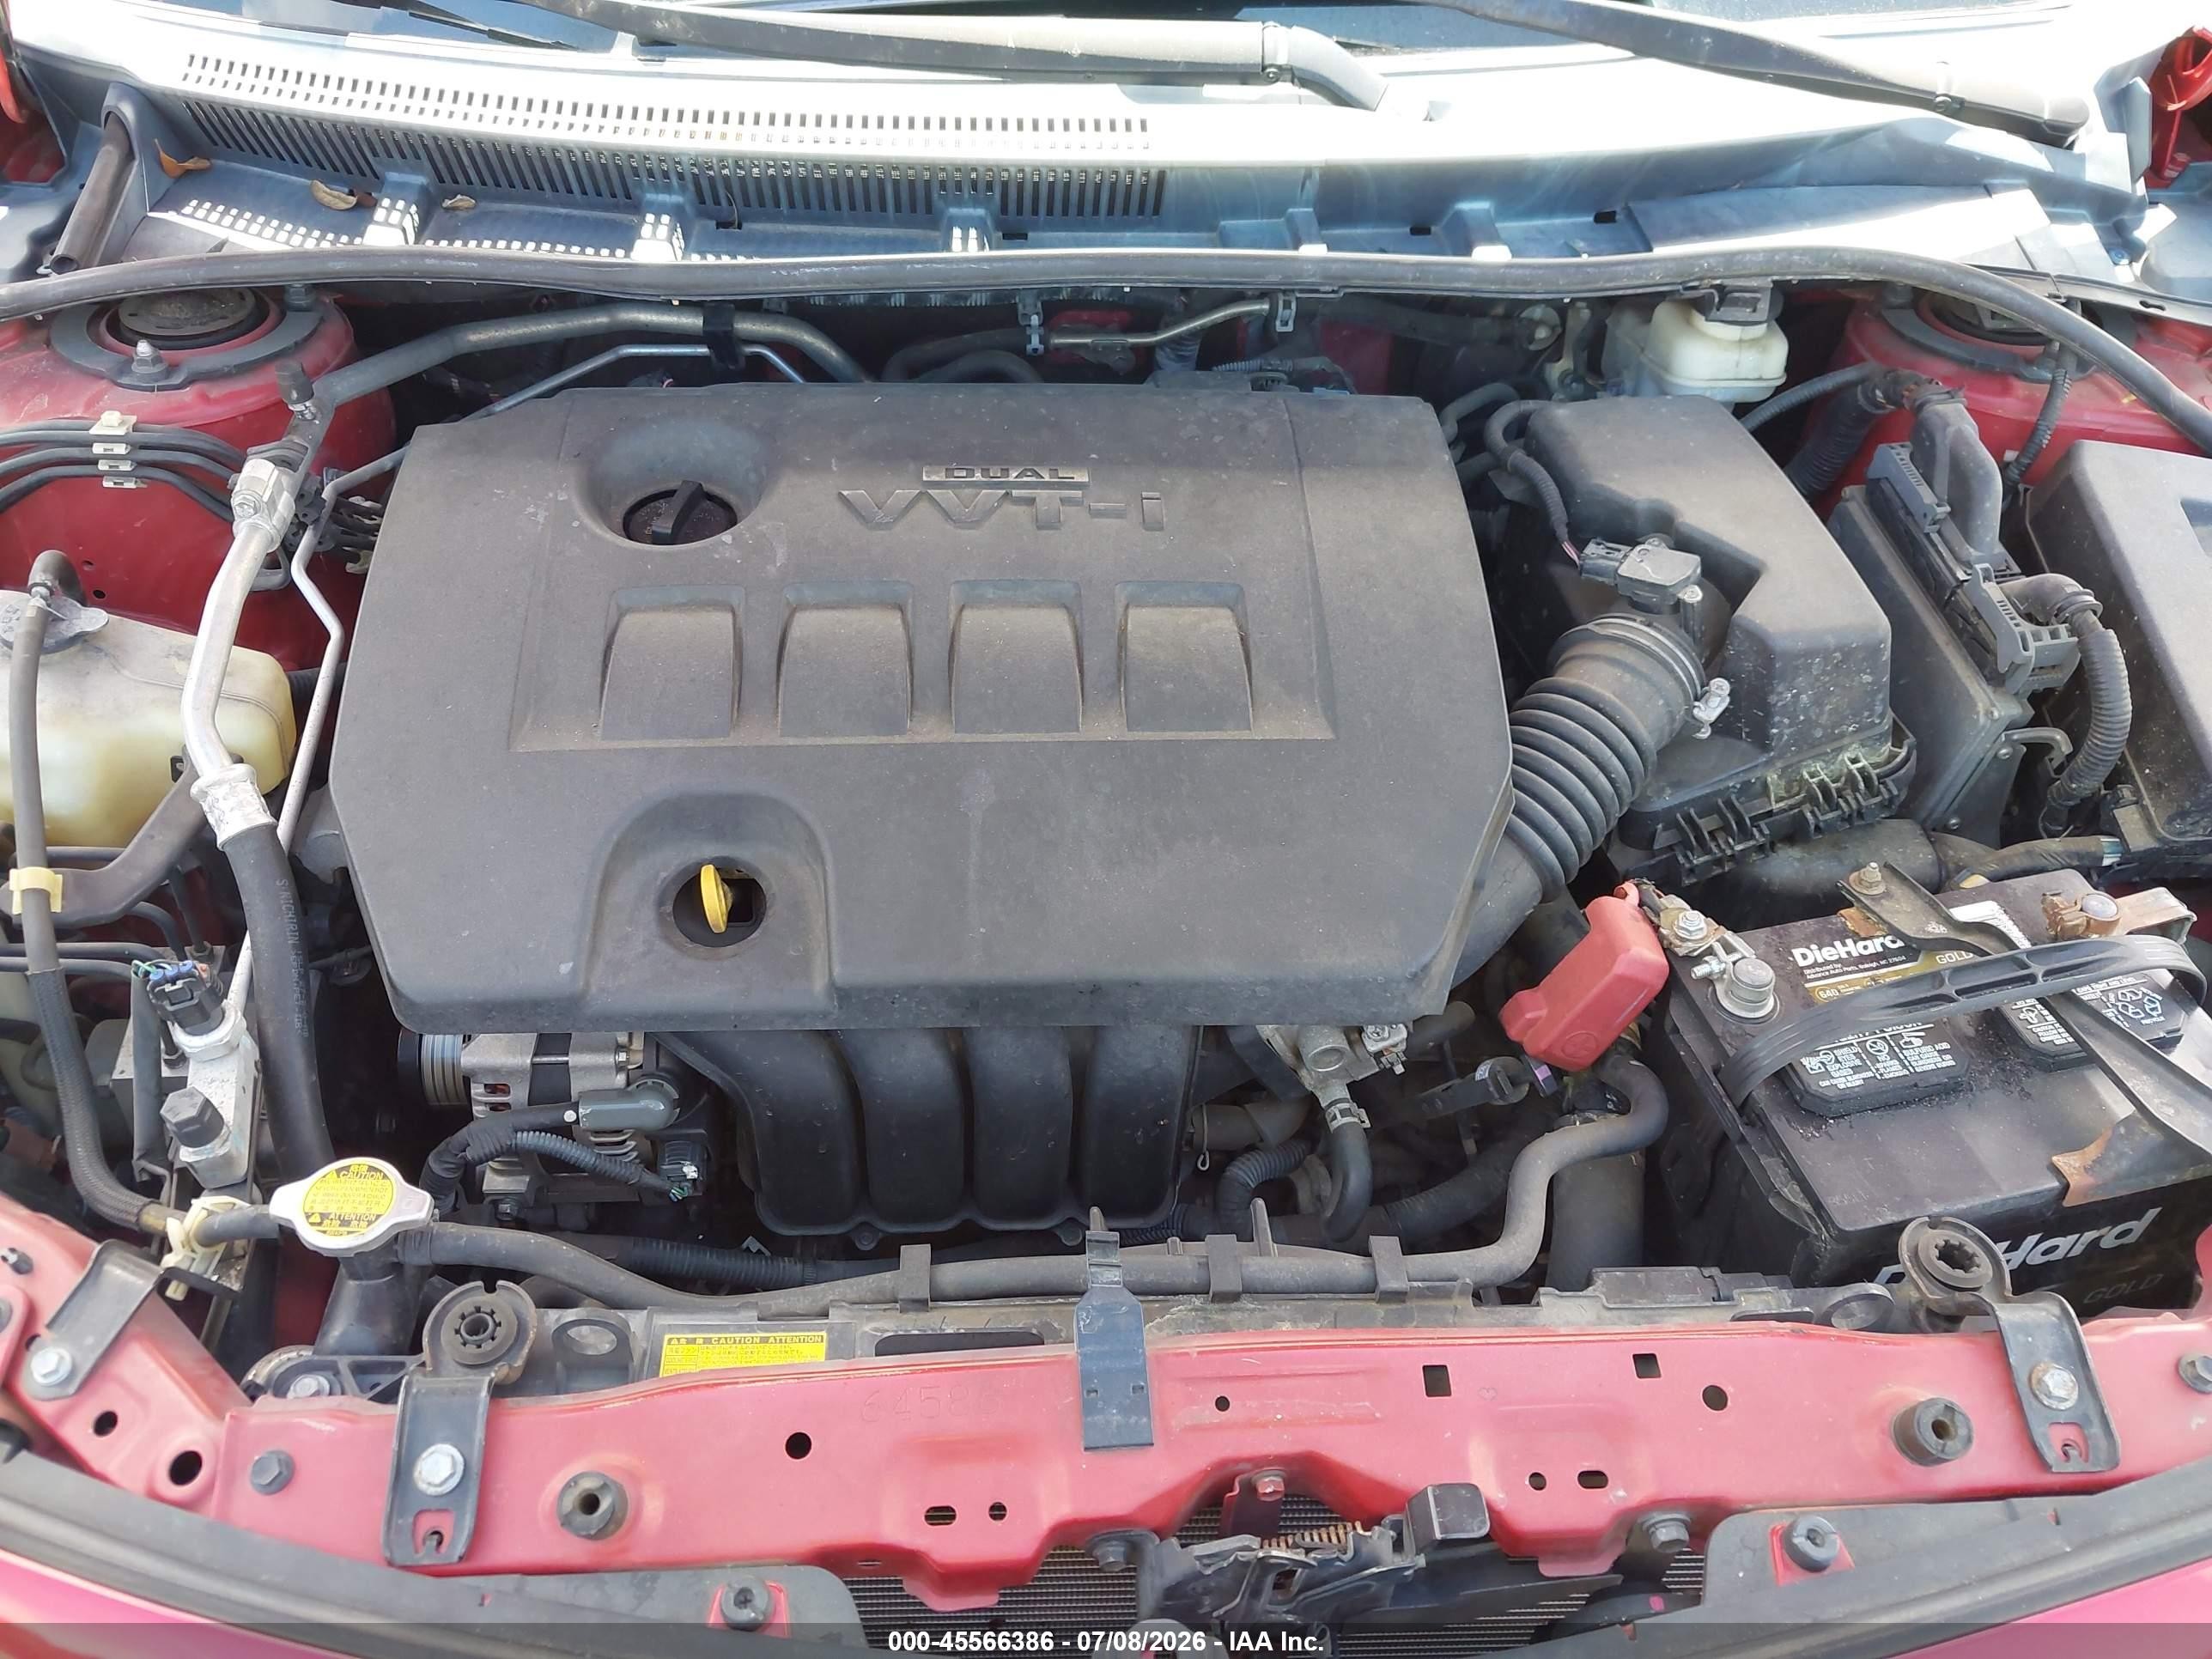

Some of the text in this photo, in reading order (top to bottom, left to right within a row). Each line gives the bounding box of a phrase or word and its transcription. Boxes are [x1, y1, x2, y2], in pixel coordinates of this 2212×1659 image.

[945, 467, 1075, 479] DUAL
[839, 489, 1164, 531] VVT-i
[1818, 988, 1839, 1000] 640
[339, 1170, 385, 1180] CAUTION
[328, 1212, 377, 1221] ATTENTION
[712, 1336, 760, 1345] CAUTION
[768, 1335, 822, 1344] ATTENTION
